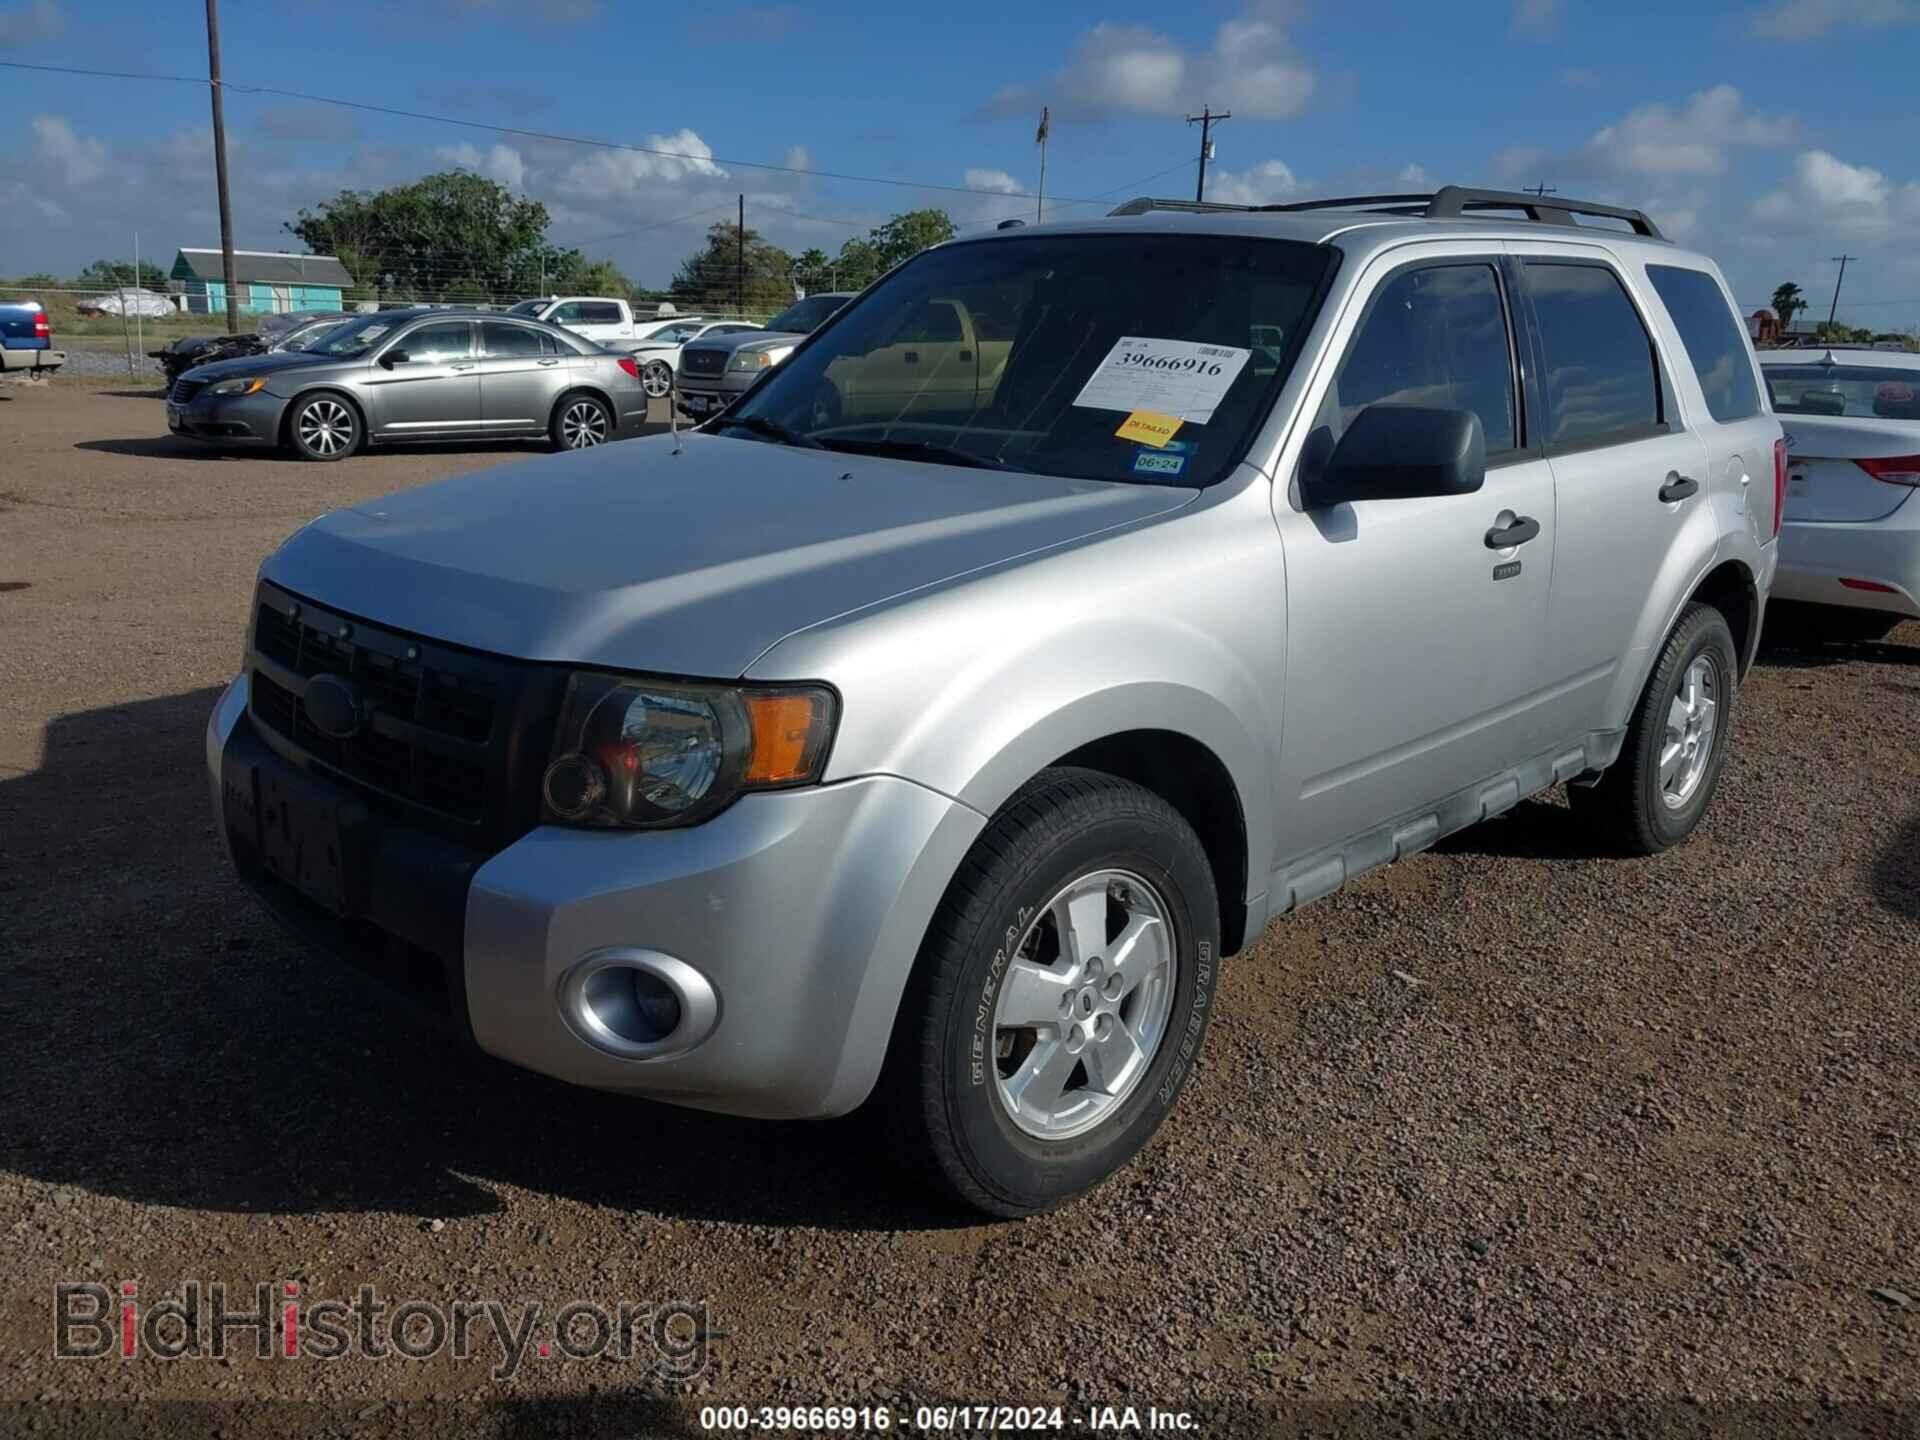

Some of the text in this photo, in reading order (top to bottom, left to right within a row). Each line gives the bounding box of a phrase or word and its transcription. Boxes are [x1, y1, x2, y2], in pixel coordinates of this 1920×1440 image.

[1115, 352, 1222, 376] 39666916
[1129, 420, 1170, 435] DETAILED
[972, 906, 1034, 1085] GENERAL
